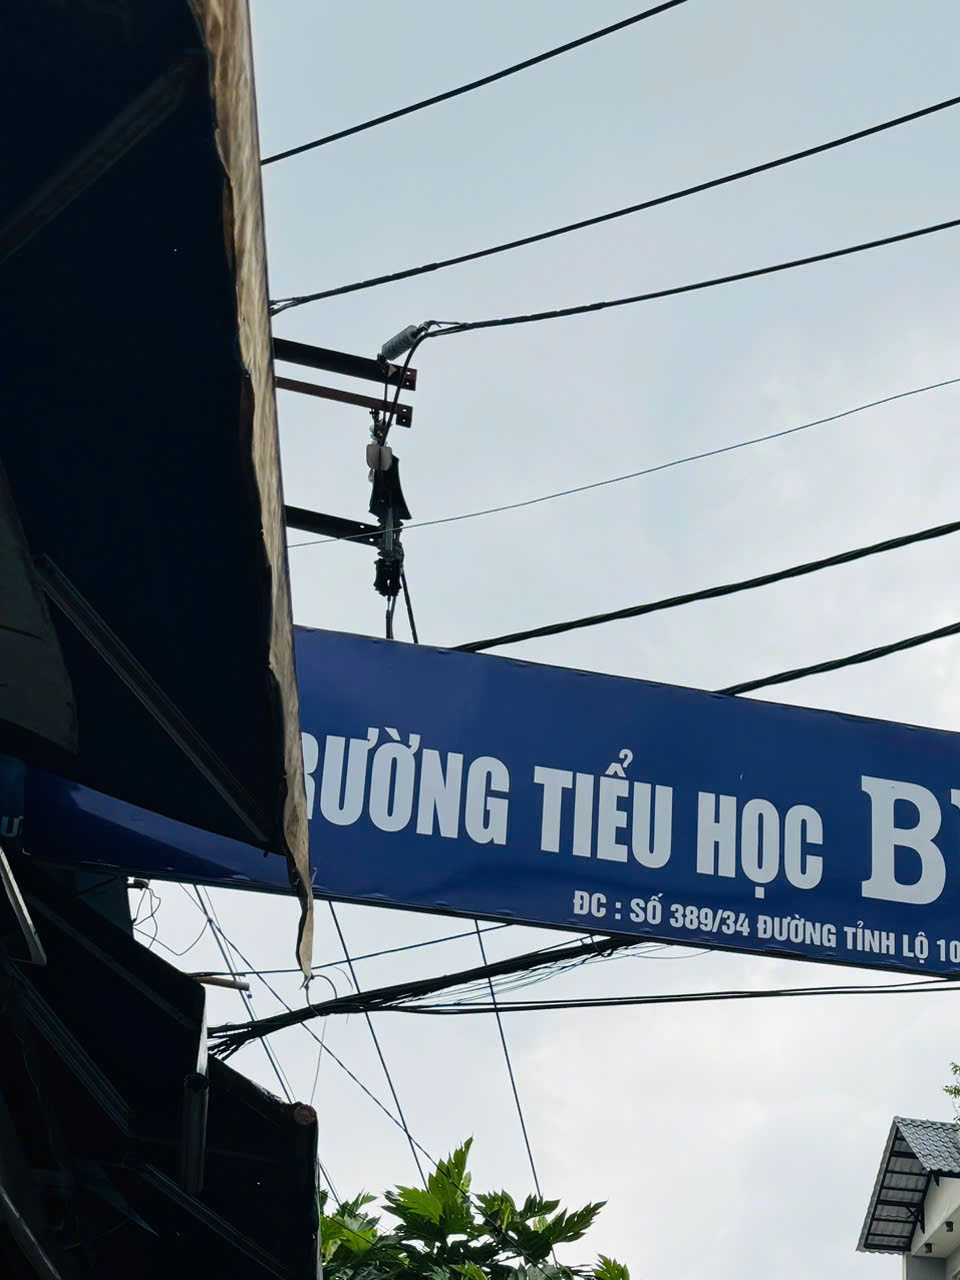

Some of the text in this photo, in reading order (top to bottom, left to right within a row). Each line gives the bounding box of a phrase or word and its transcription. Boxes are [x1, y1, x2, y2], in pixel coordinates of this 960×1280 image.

[534, 749, 673, 868] TIỂU
[697, 791, 823, 898] HỌC
[573, 890, 607, 918] ĐC
[630, 893, 663, 925] SỐ
[670, 903, 750, 936] 389/34
[757, 914, 837, 948] ĐƯỜNG
[844, 920, 895, 955] TỈNH
[903, 931, 929, 964] LỘ
